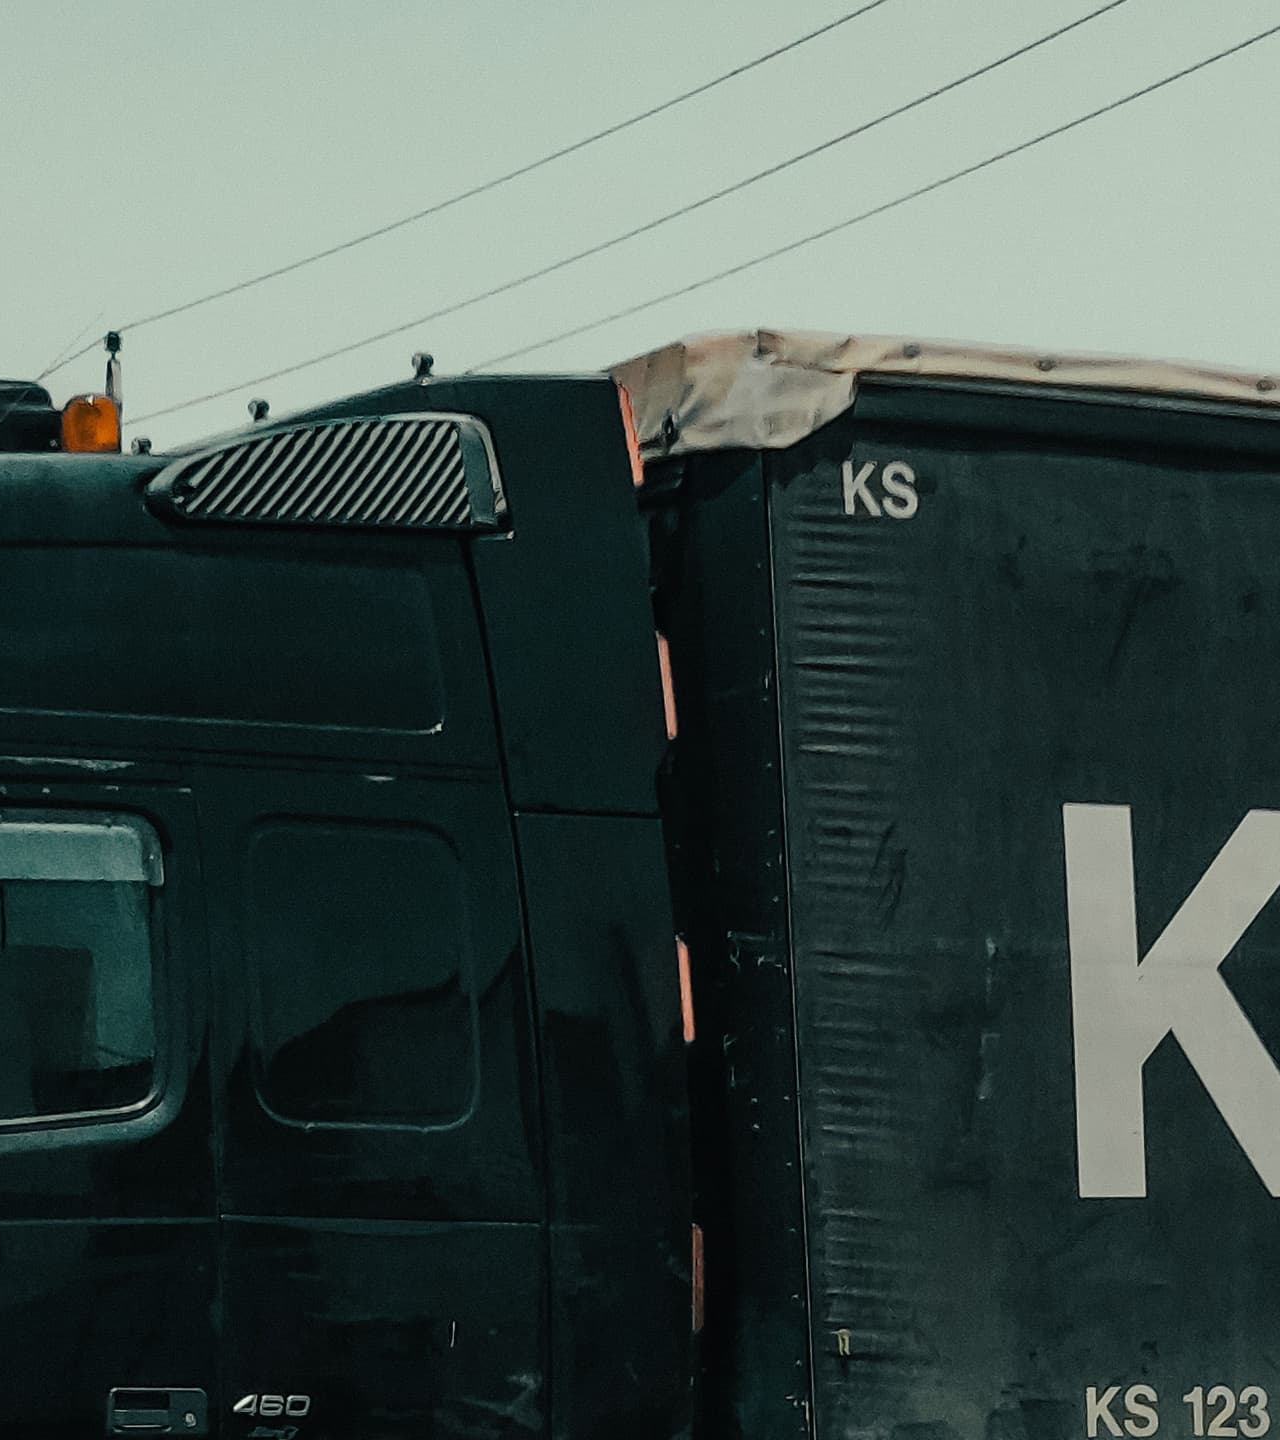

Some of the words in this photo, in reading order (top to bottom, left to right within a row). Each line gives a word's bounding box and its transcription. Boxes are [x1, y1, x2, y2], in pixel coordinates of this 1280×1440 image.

[842, 460, 919, 520] KS
[232, 1394, 311, 1417] 460
[1086, 1384, 1160, 1438] KS
[1182, 1385, 1271, 1439] 123
